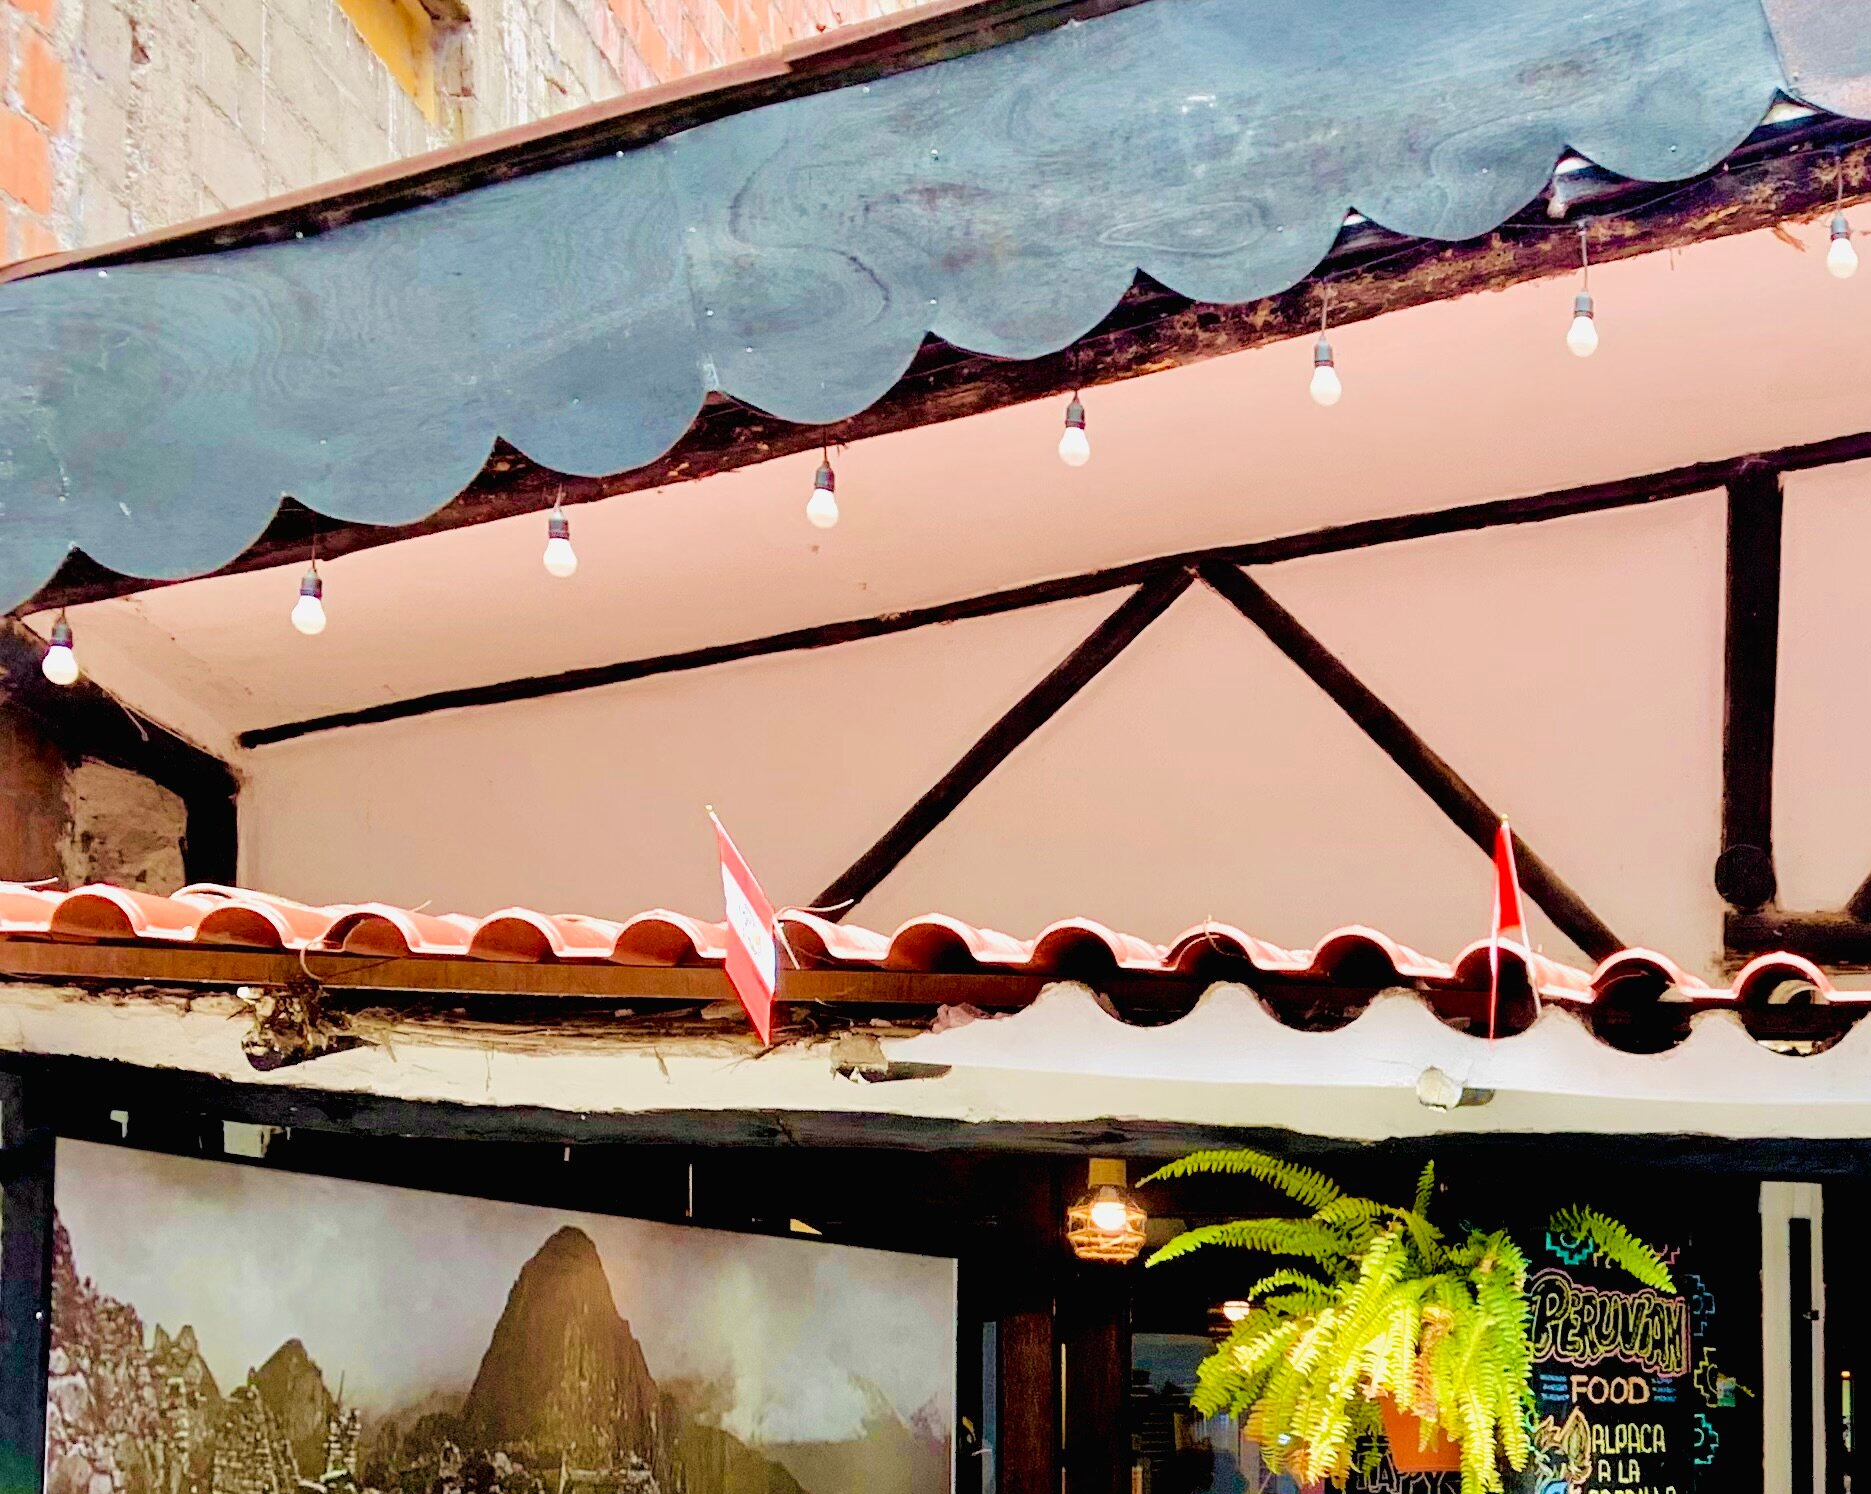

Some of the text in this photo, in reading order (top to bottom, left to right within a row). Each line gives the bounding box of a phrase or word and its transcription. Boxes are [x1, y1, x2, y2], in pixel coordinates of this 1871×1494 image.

[1530, 1271, 1688, 1375] PERUVIAN
[1569, 1374, 1651, 1405] FOOD
[1591, 1422, 1666, 1454] ALPACA
[1598, 1459, 1641, 1483] A LA
